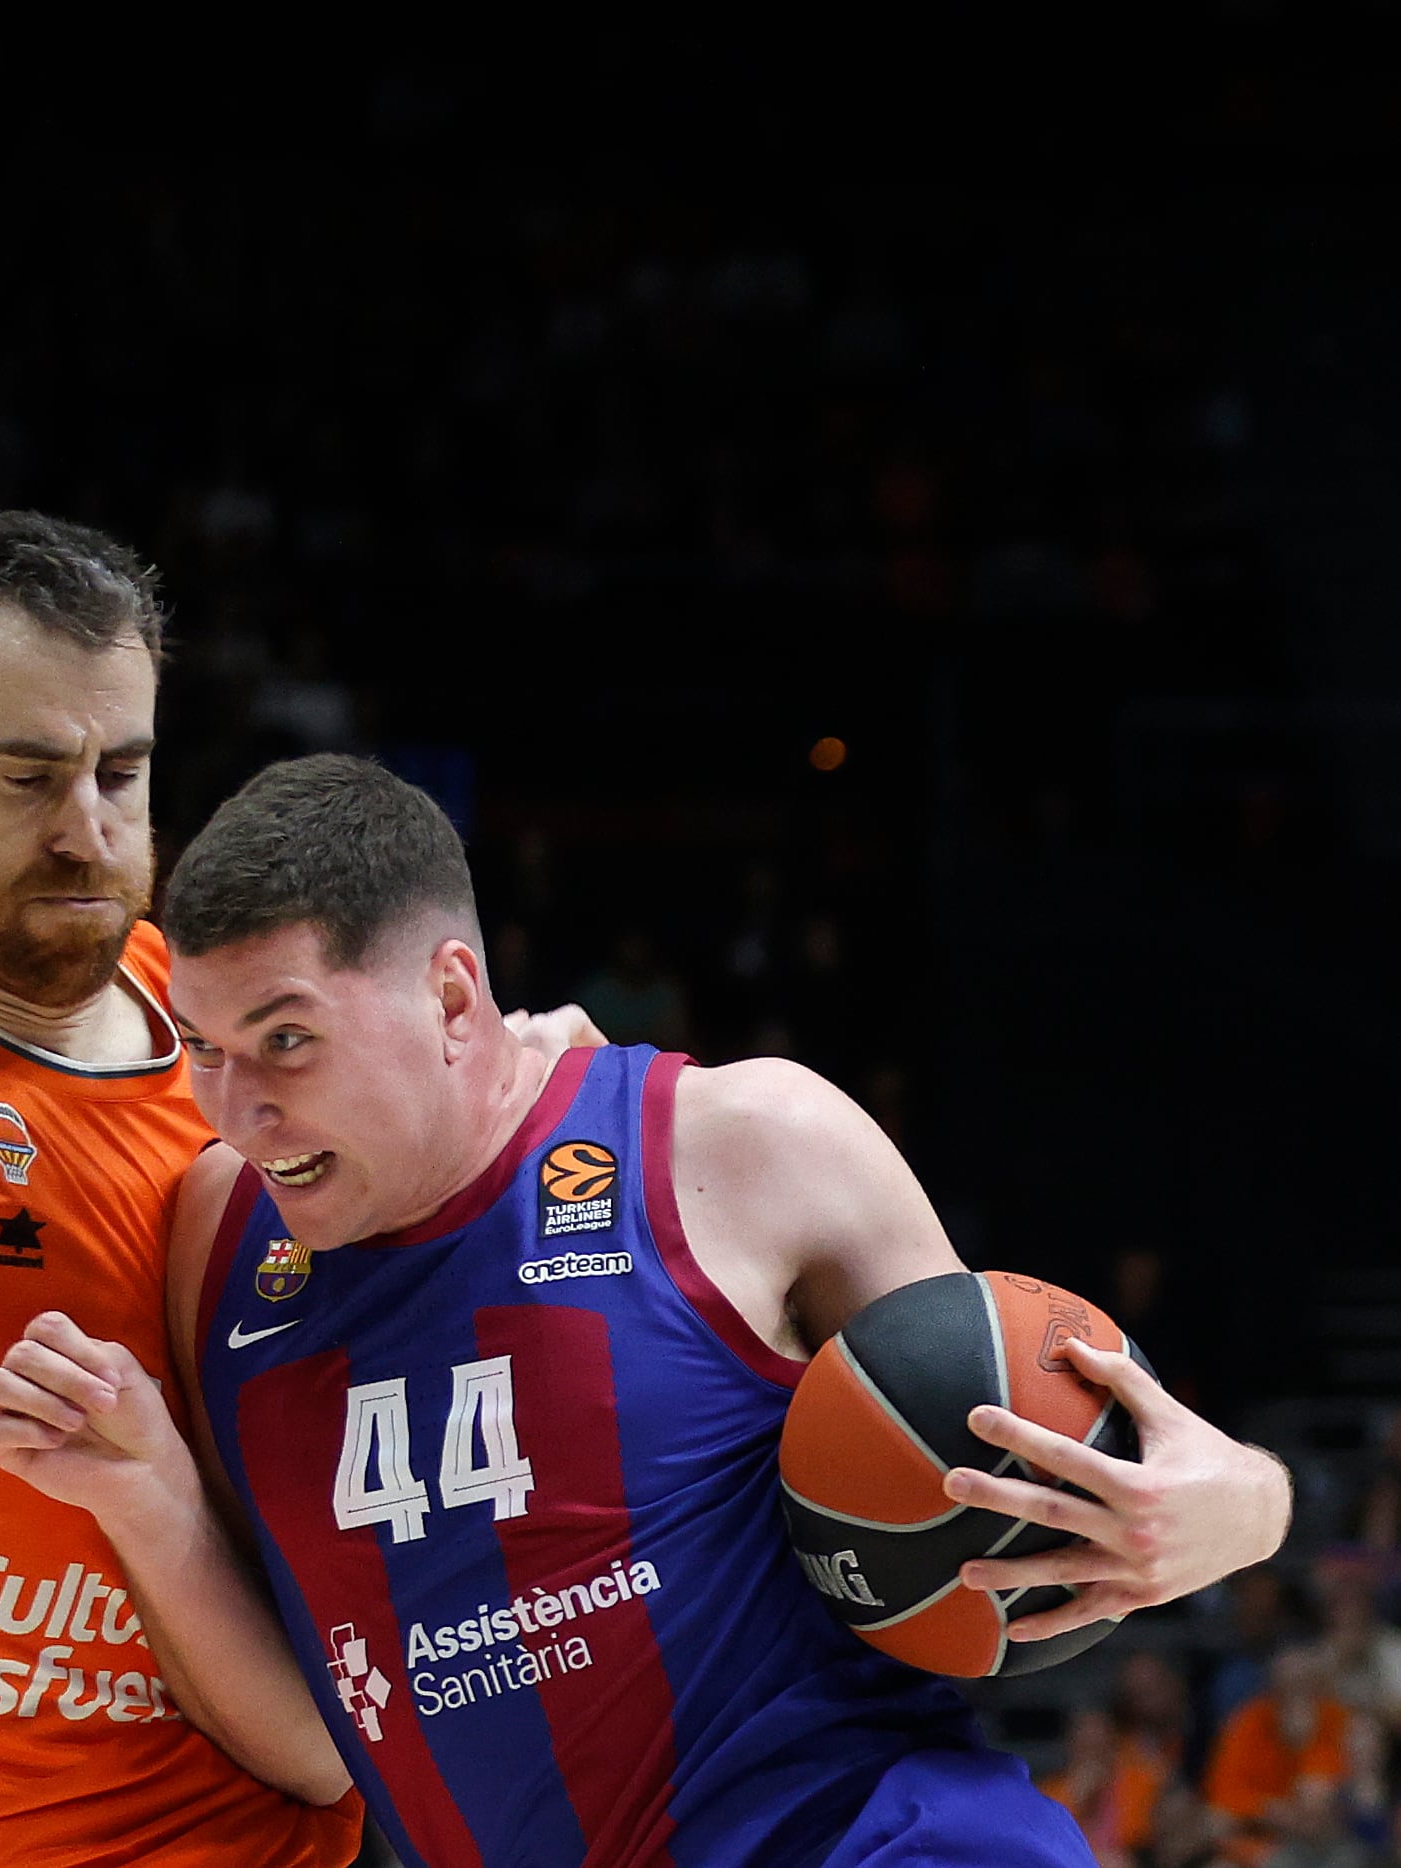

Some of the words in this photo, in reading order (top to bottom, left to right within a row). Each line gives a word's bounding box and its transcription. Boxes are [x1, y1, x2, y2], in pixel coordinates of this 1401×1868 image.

[546, 1198, 612, 1217] TURKISH
[546, 1208, 612, 1227] AIRLINES
[545, 1219, 612, 1235] EuroLeague
[520, 1253, 631, 1282] oneteam
[333, 1355, 535, 1543] 44
[406, 1560, 662, 1669] Assistència
[413, 1632, 594, 1716] Sanitària
